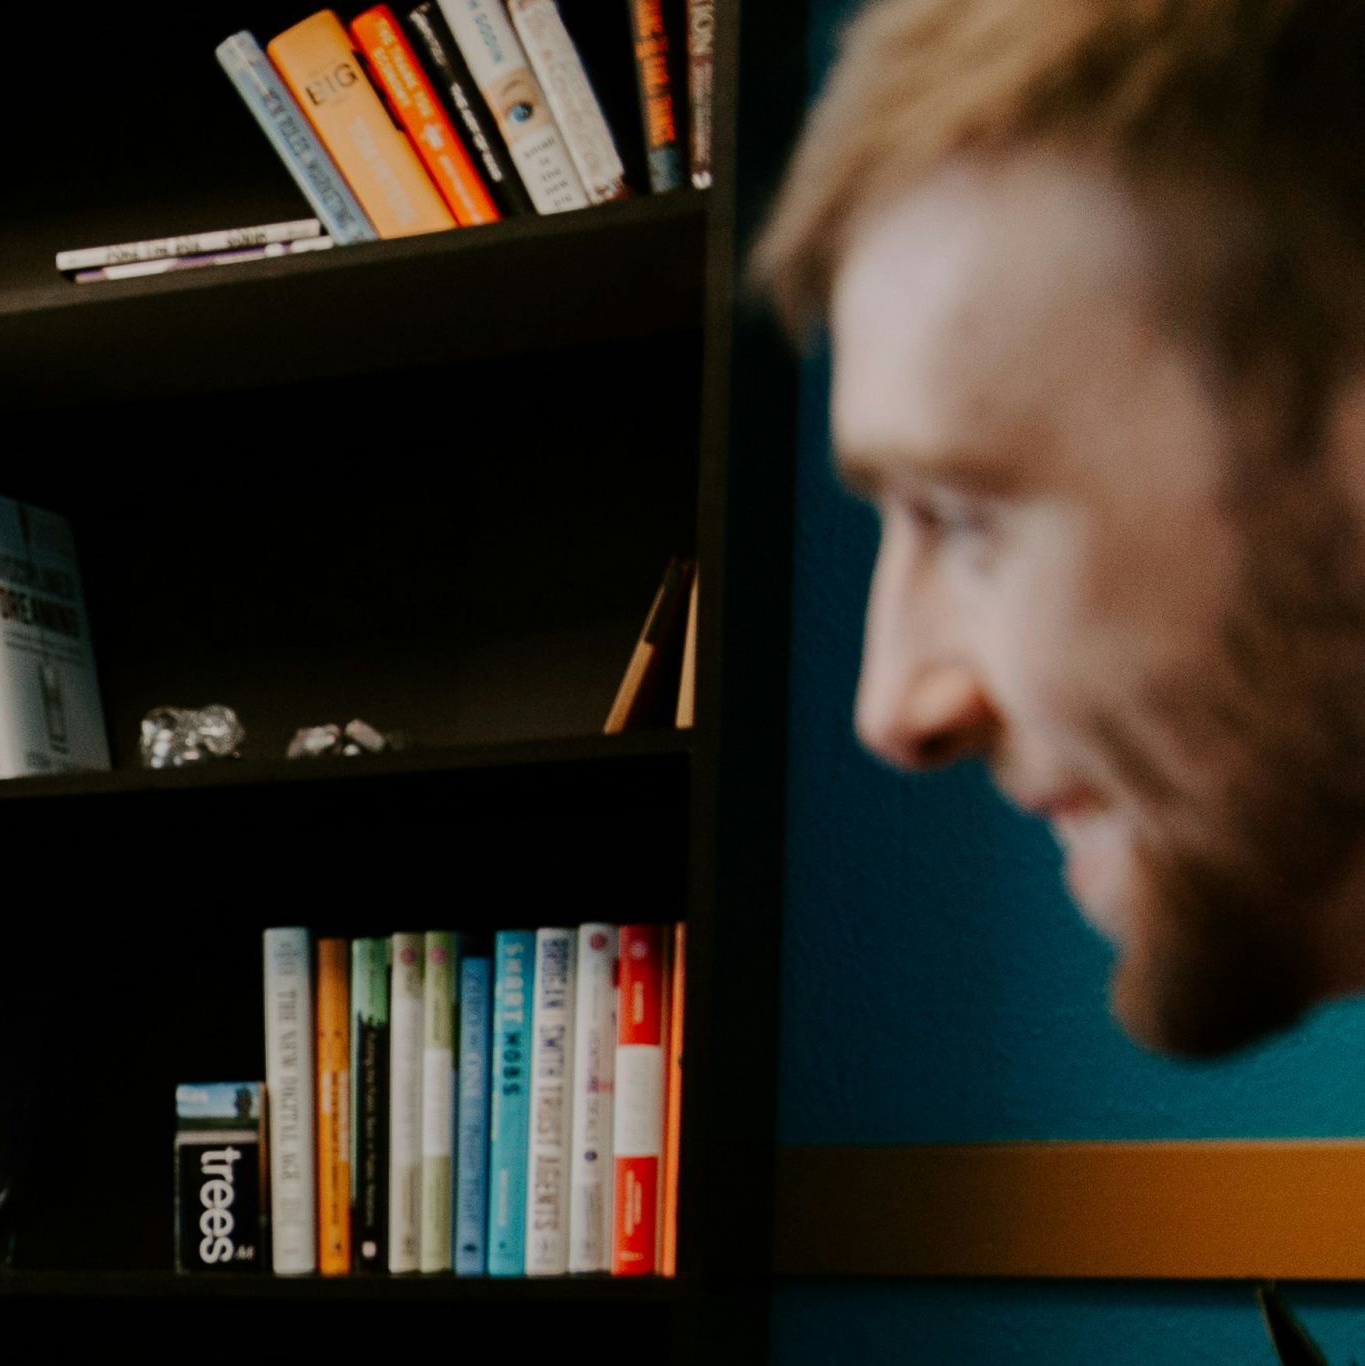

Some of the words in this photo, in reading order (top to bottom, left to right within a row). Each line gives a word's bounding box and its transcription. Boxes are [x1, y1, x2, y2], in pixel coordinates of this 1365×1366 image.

[277, 990, 297, 1023] THE
[277, 1030, 297, 1068] NEW
[536, 1086, 564, 1146] TRUST
[278, 1153, 298, 1181] AGE
[199, 1147, 243, 1264] trees
[534, 1155, 562, 1231] AGENTS
